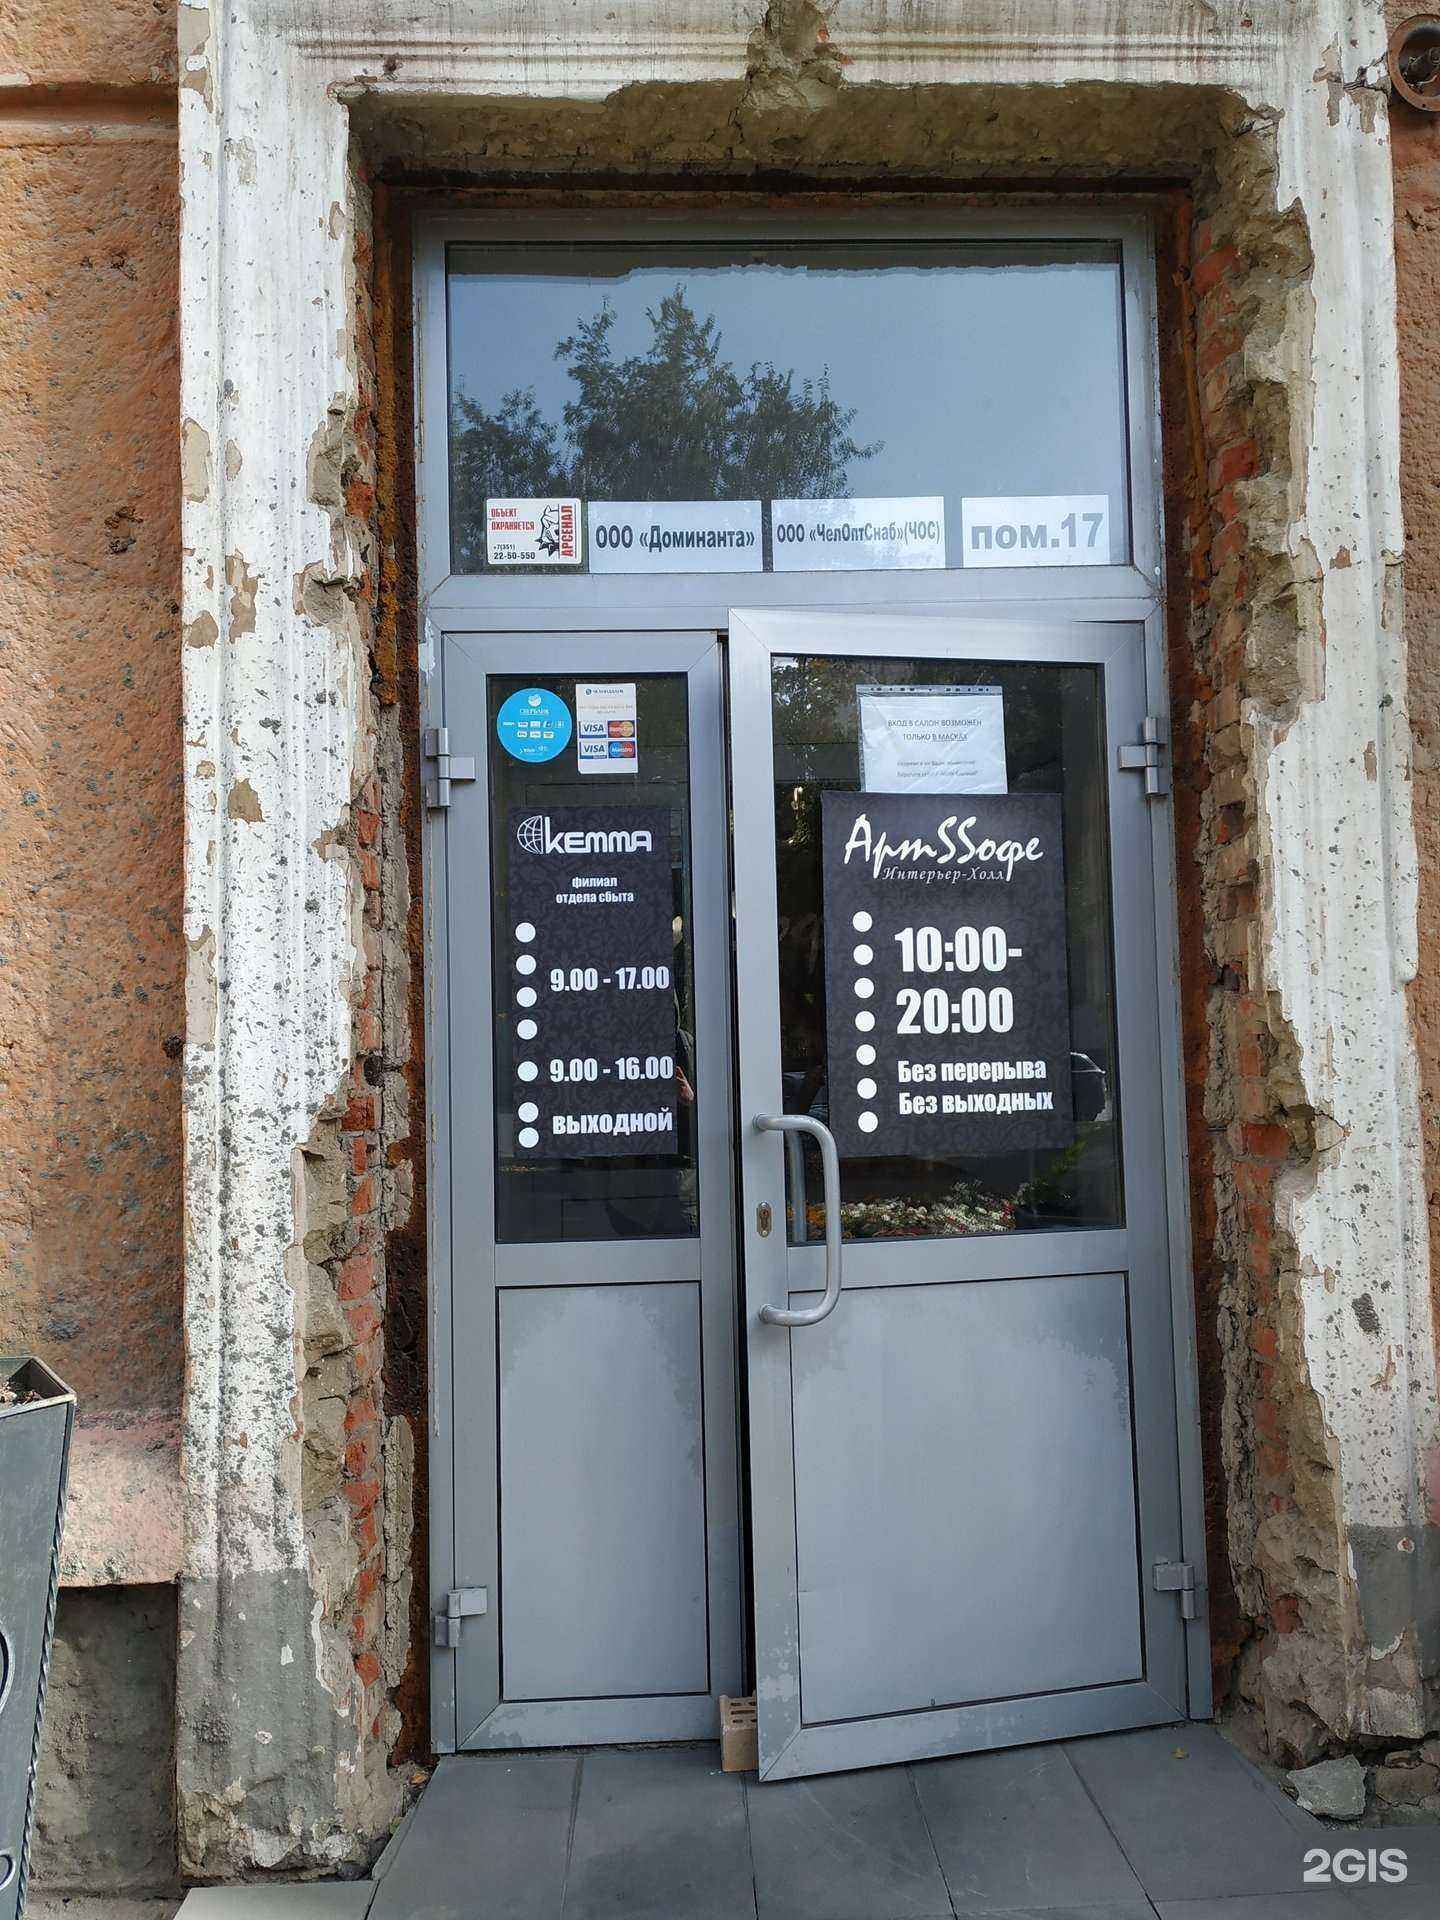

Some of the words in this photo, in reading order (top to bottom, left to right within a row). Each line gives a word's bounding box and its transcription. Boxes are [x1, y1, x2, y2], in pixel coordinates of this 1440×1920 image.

[491, 508, 518, 518] ОБЪЕКТ
[491, 521, 535, 531] ОХРАНЯЕТСЯ
[561, 505, 574, 557] АРСЕНАЛ
[776, 524, 805, 544] ООО
[971, 513, 1104, 550] пом.17
[595, 525, 634, 549] ООО
[639, 525, 755, 552] «Доминанта»
[493, 552, 536, 560] 22-50-550
[583, 724, 605, 733] VISA
[583, 744, 606, 753] VISA
[572, 876, 618, 888] филиал
[881, 866, 1005, 884] Интерьер-Холл
[556, 891, 597, 904] отдела
[598, 891, 634, 902] сбыта
[550, 967, 599, 992] 9.00
[615, 966, 670, 990] 17.00
[896, 987, 1014, 1035] 20:00
[549, 1058, 598, 1082] 9.00
[615, 1056, 674, 1080] 16.00
[897, 1060, 937, 1083] Без
[941, 1060, 1047, 1083] перерыва
[899, 1092, 938, 1115] Без
[942, 1092, 1054, 1115] выходных
